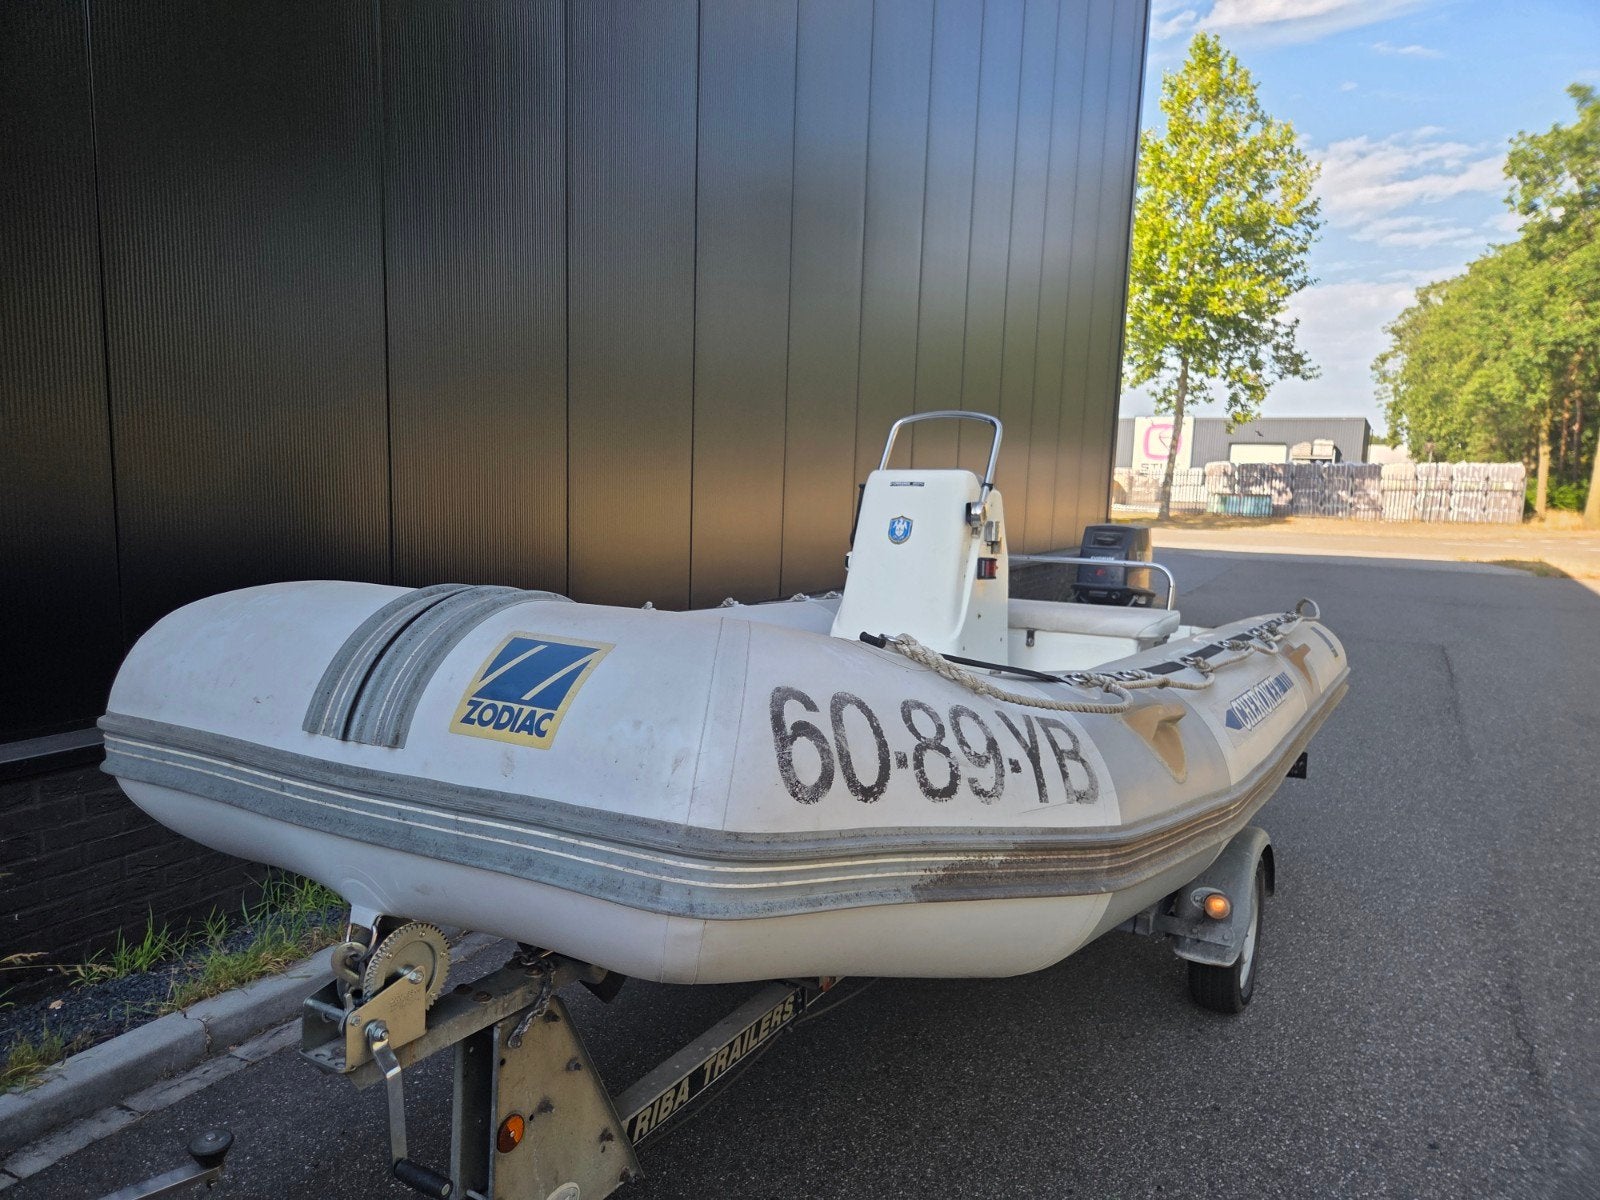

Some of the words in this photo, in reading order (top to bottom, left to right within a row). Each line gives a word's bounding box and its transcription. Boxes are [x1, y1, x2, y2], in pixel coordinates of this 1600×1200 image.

[460, 700, 555, 737] ZODIAC
[634, 1077, 690, 1142] RIBA
[702, 994, 795, 1085] TRAILERS
